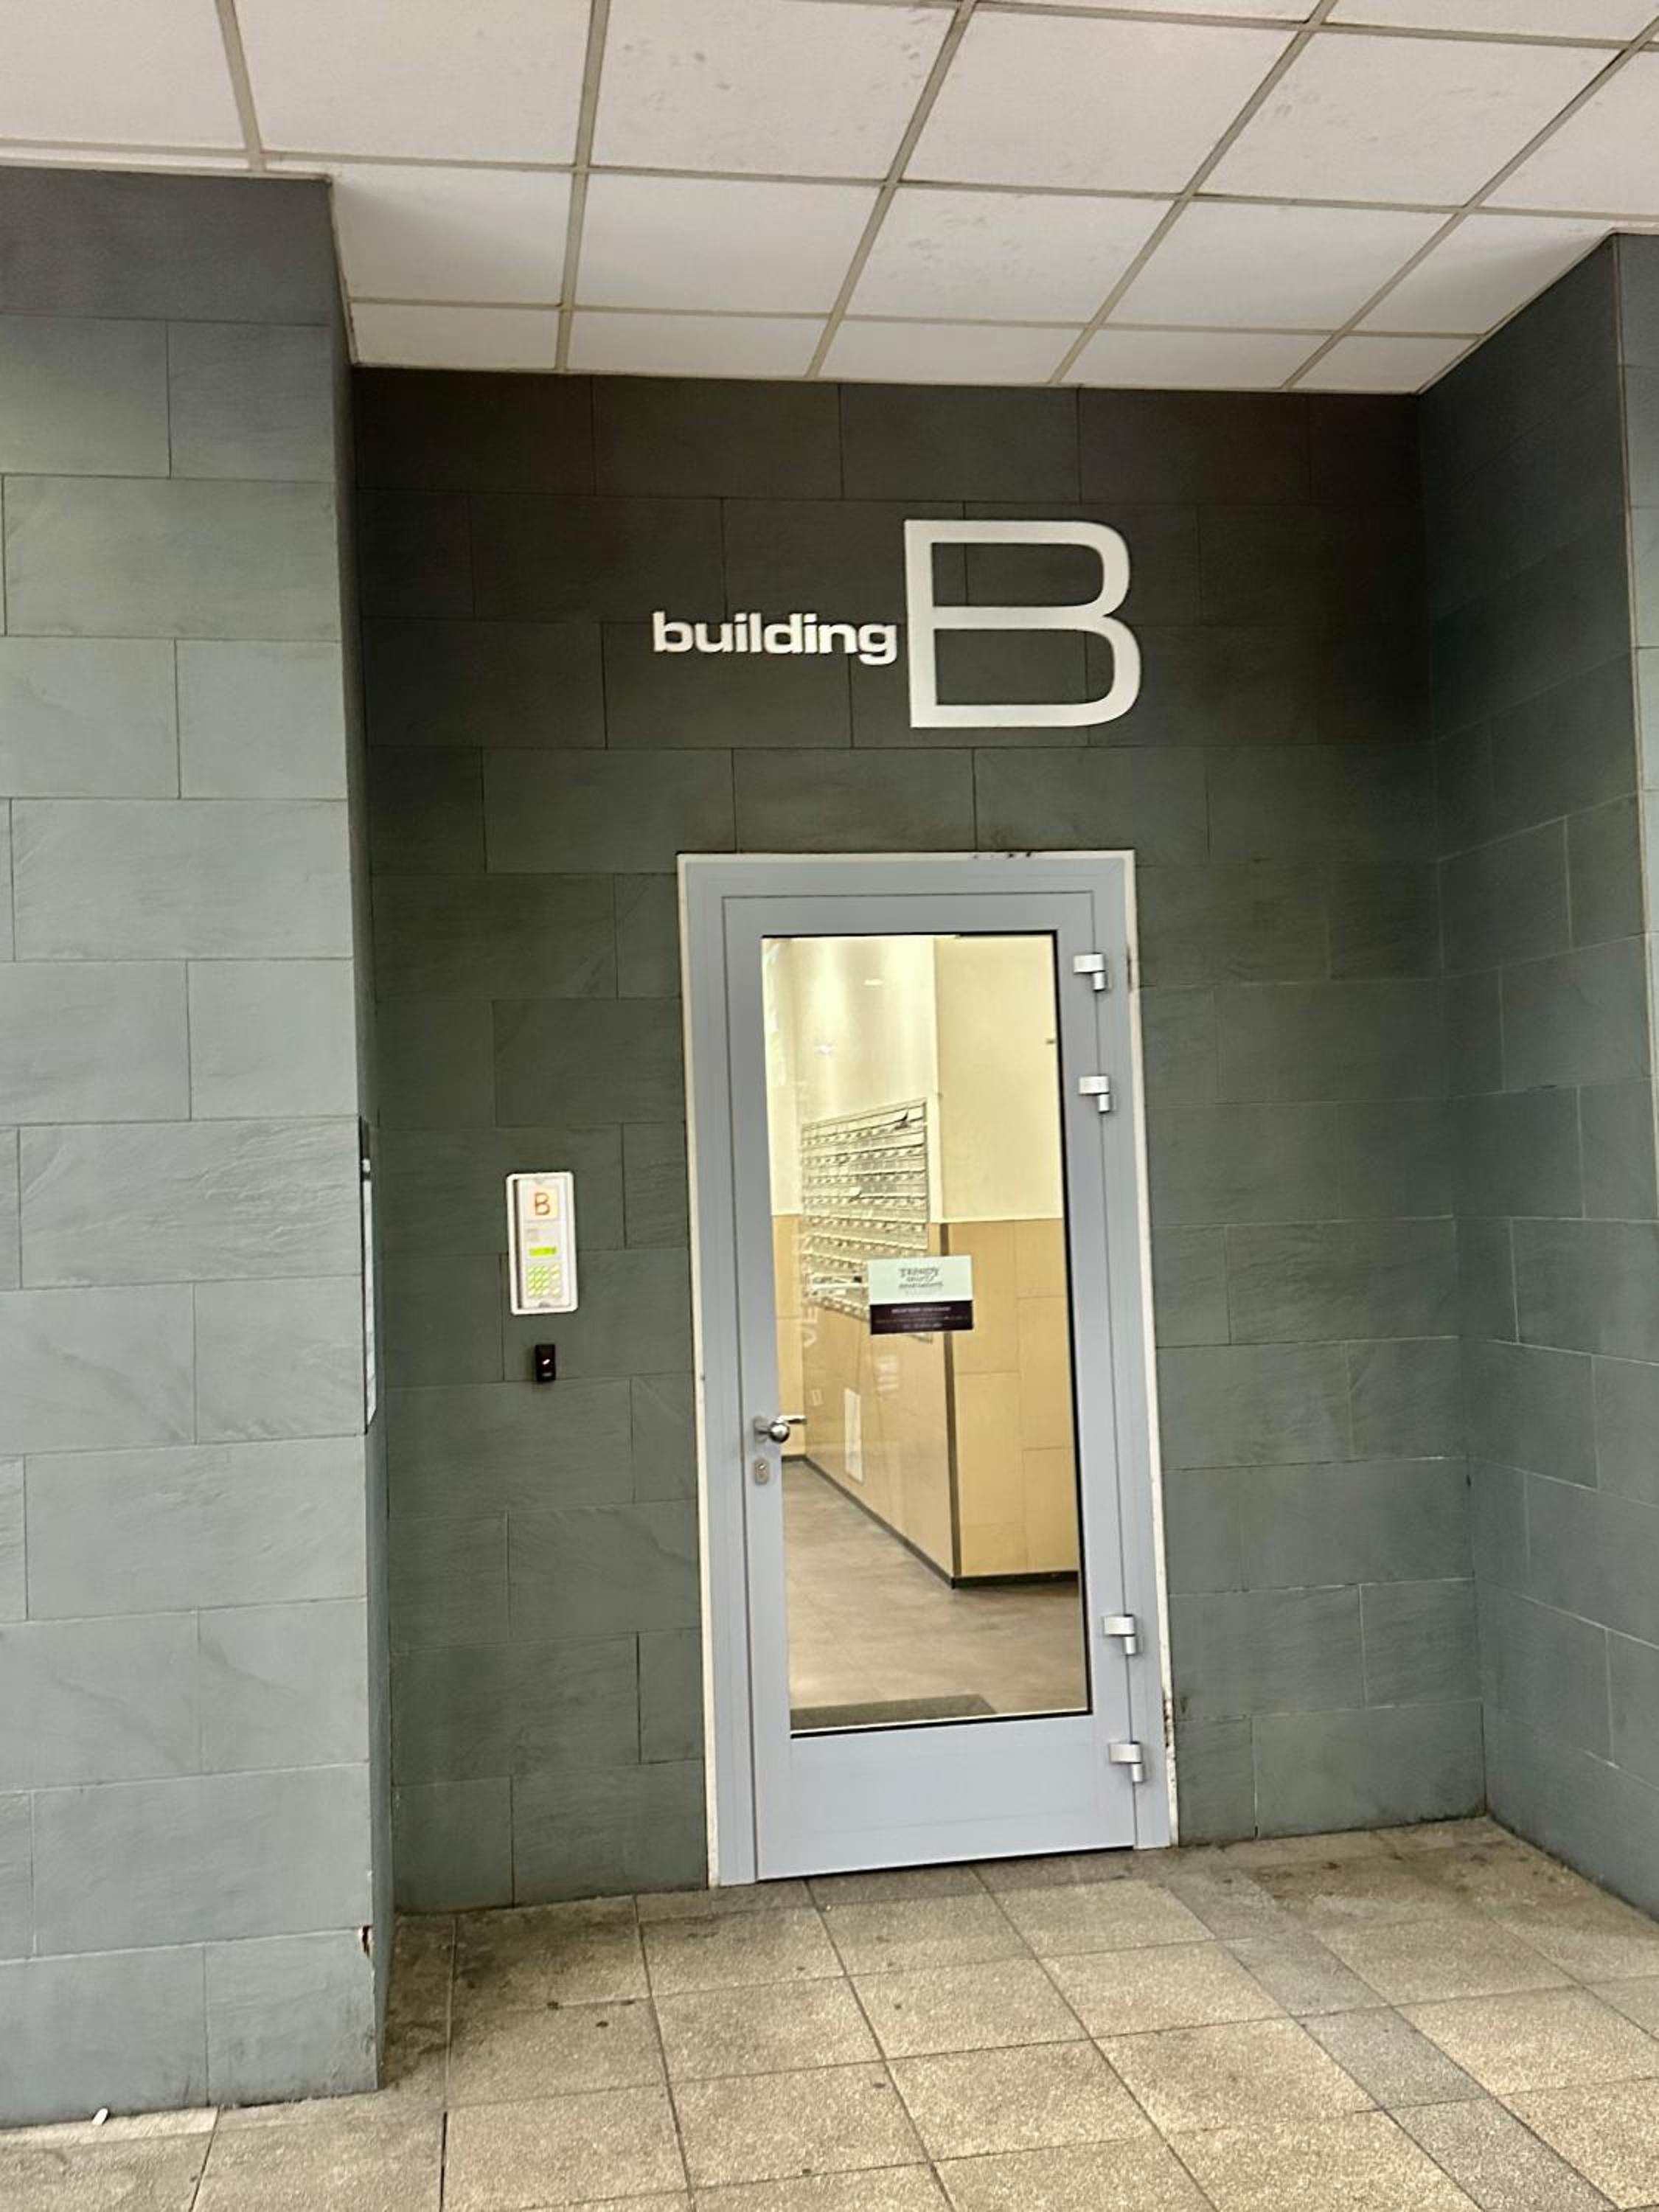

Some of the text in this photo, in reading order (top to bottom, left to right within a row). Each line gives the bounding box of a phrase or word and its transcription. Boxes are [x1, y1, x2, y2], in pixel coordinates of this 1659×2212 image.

[653, 520, 1141, 728] building B
[535, 1192, 551, 1215] B
